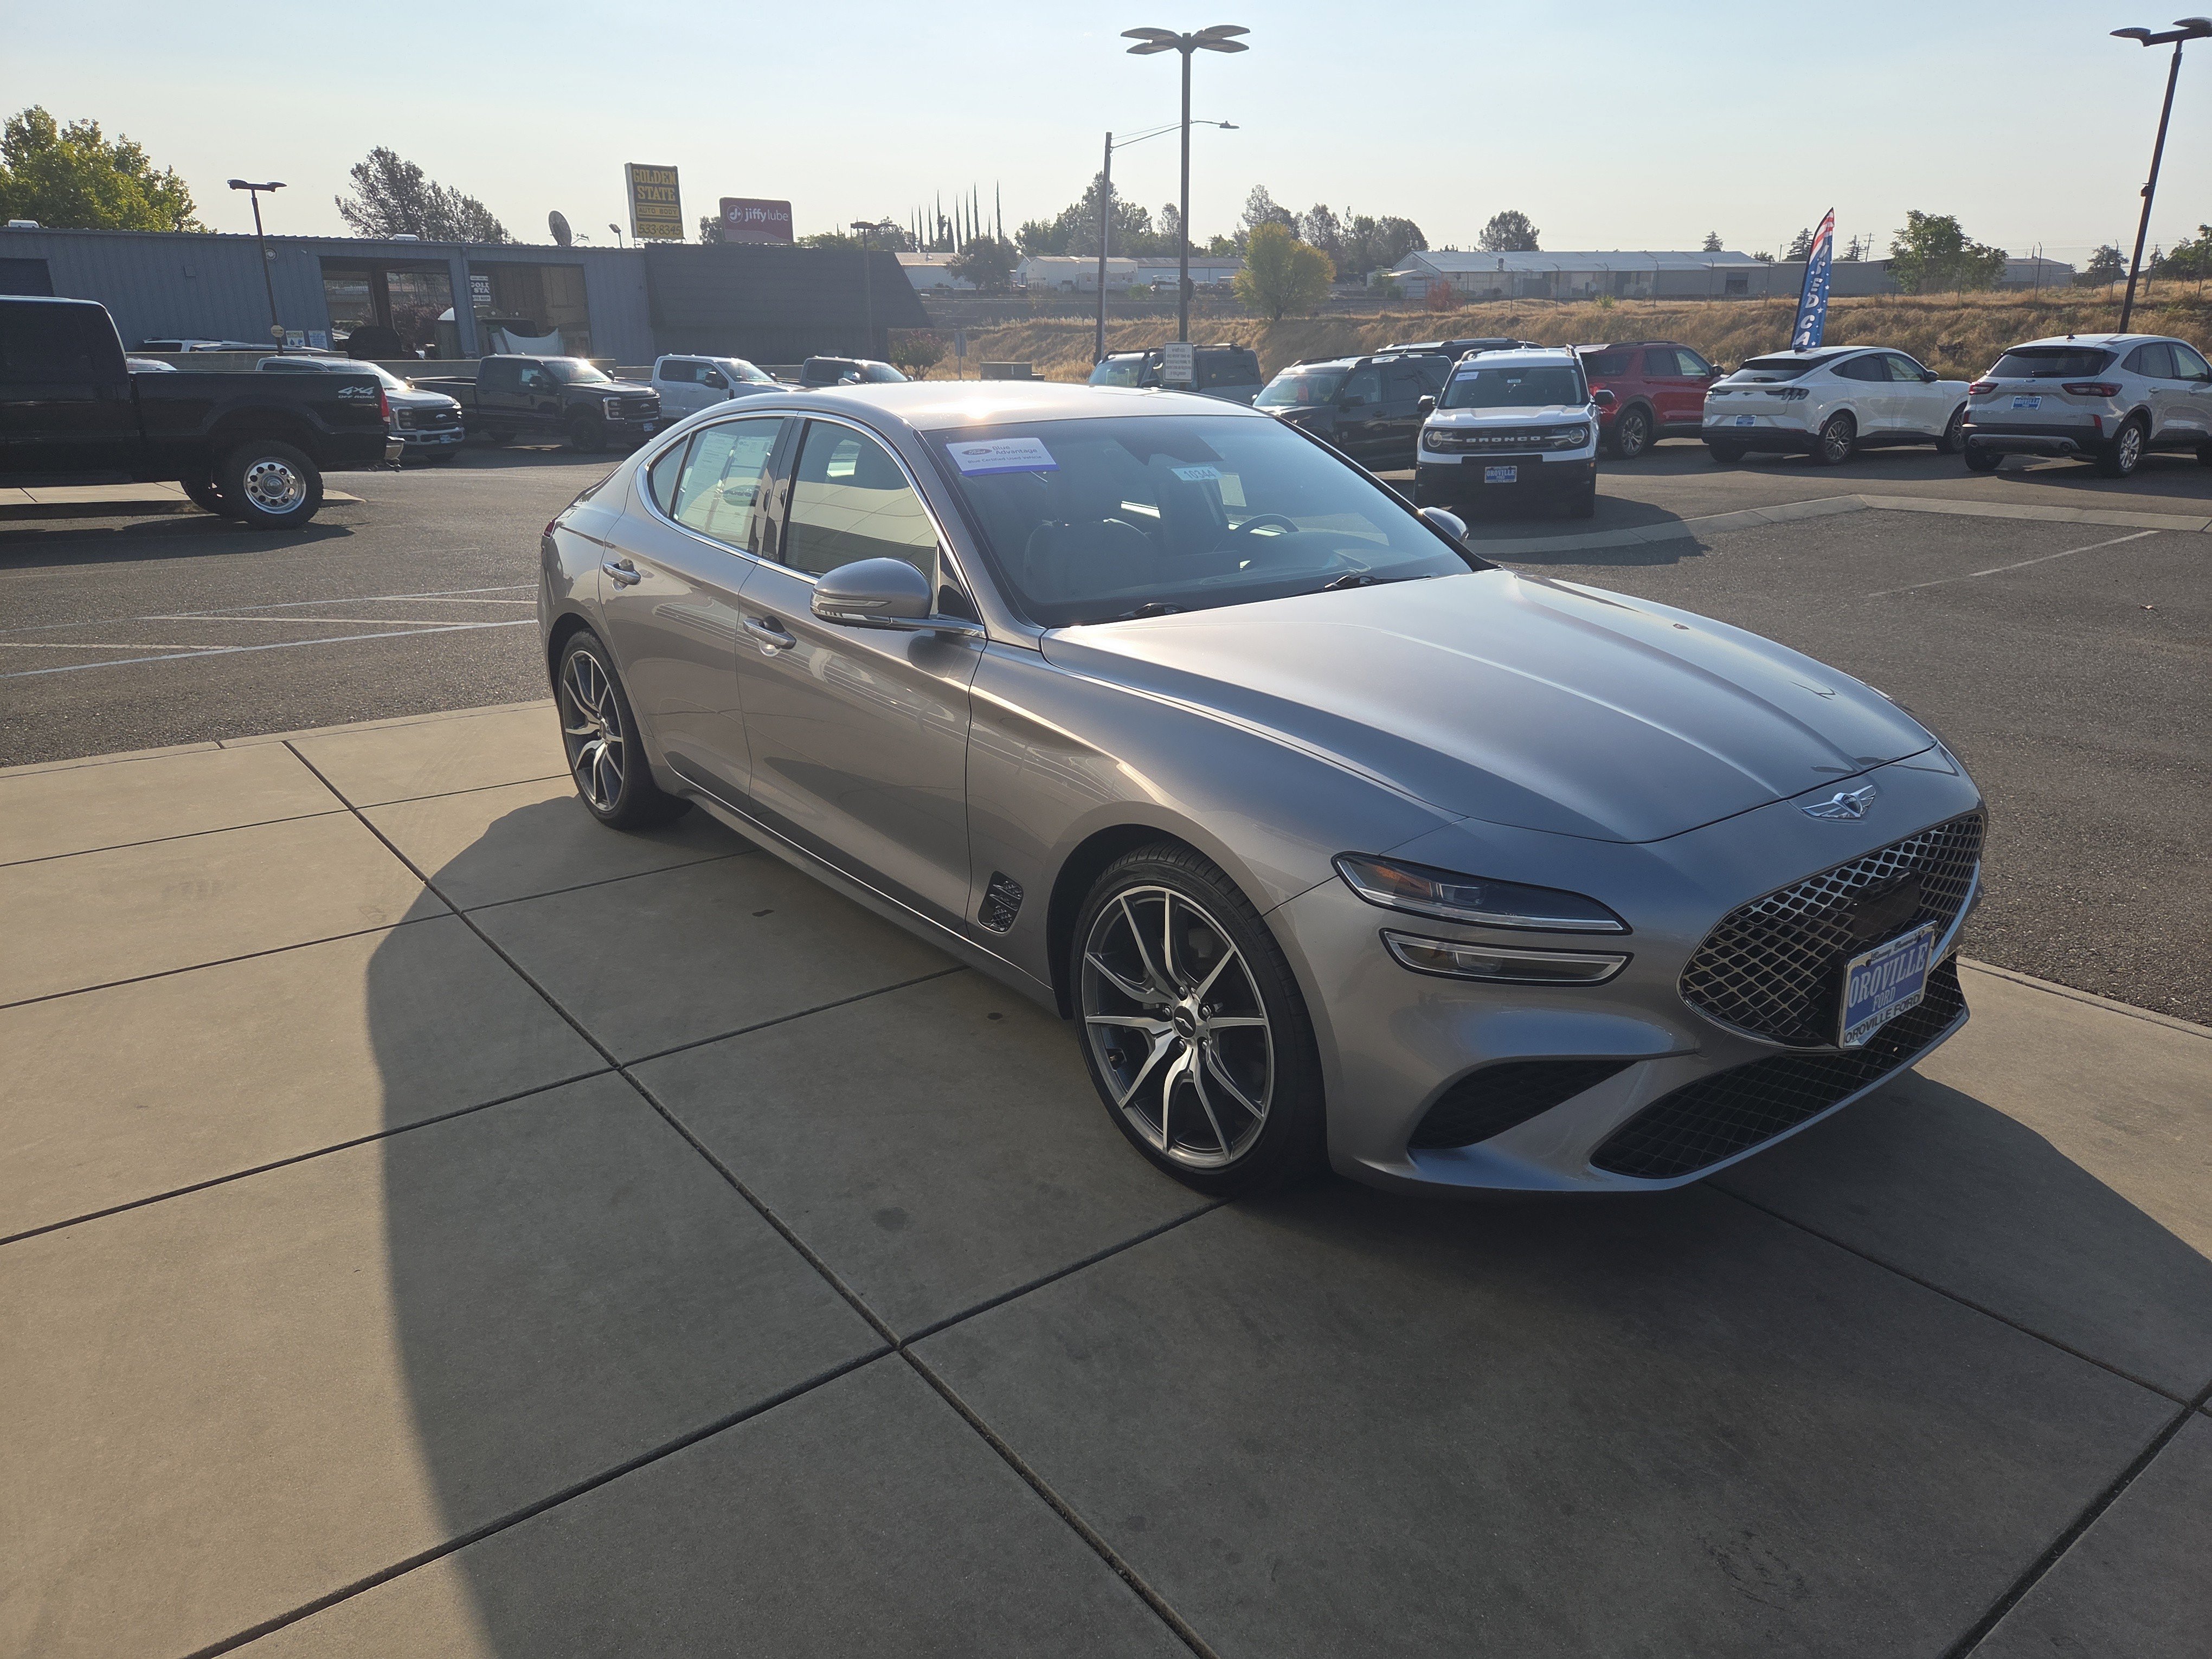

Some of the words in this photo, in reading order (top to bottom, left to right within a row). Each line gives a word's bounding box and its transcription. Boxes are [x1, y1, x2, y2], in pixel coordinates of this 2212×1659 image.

[633, 169, 677, 185] GOLDEN
[636, 185, 676, 201] STATE
[744, 208, 767, 222] jiffy
[767, 209, 789, 221] lube
[1848, 942, 1929, 1008] OROVILLE
[1872, 986, 1896, 1012] FORD
[1844, 1008, 1893, 1044] OROVILLE
[1893, 994, 1921, 1016] FORD
